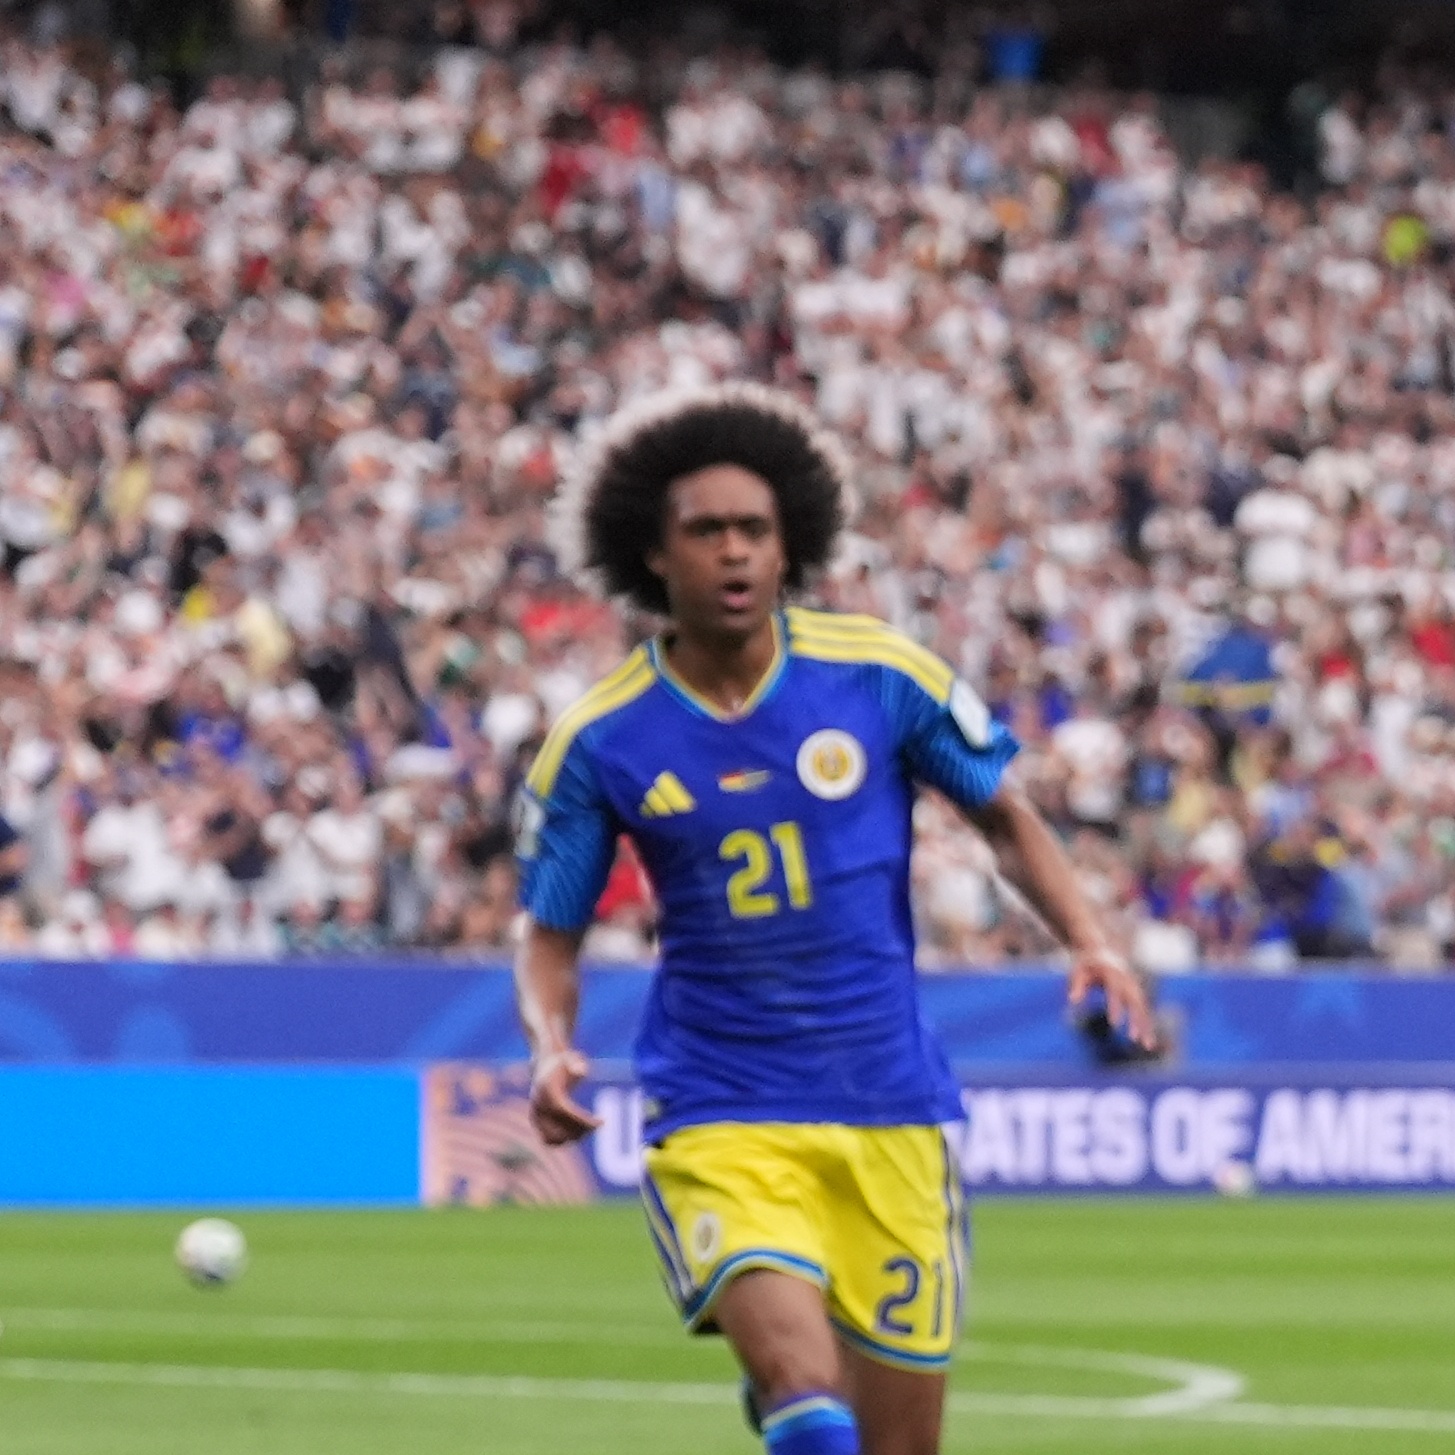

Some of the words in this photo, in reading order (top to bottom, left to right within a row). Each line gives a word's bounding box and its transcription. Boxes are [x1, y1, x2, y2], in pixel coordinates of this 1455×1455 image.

[718, 822, 811, 919] 21
[1152, 1087, 1254, 1186] OF
[875, 1258, 946, 1338] 21
